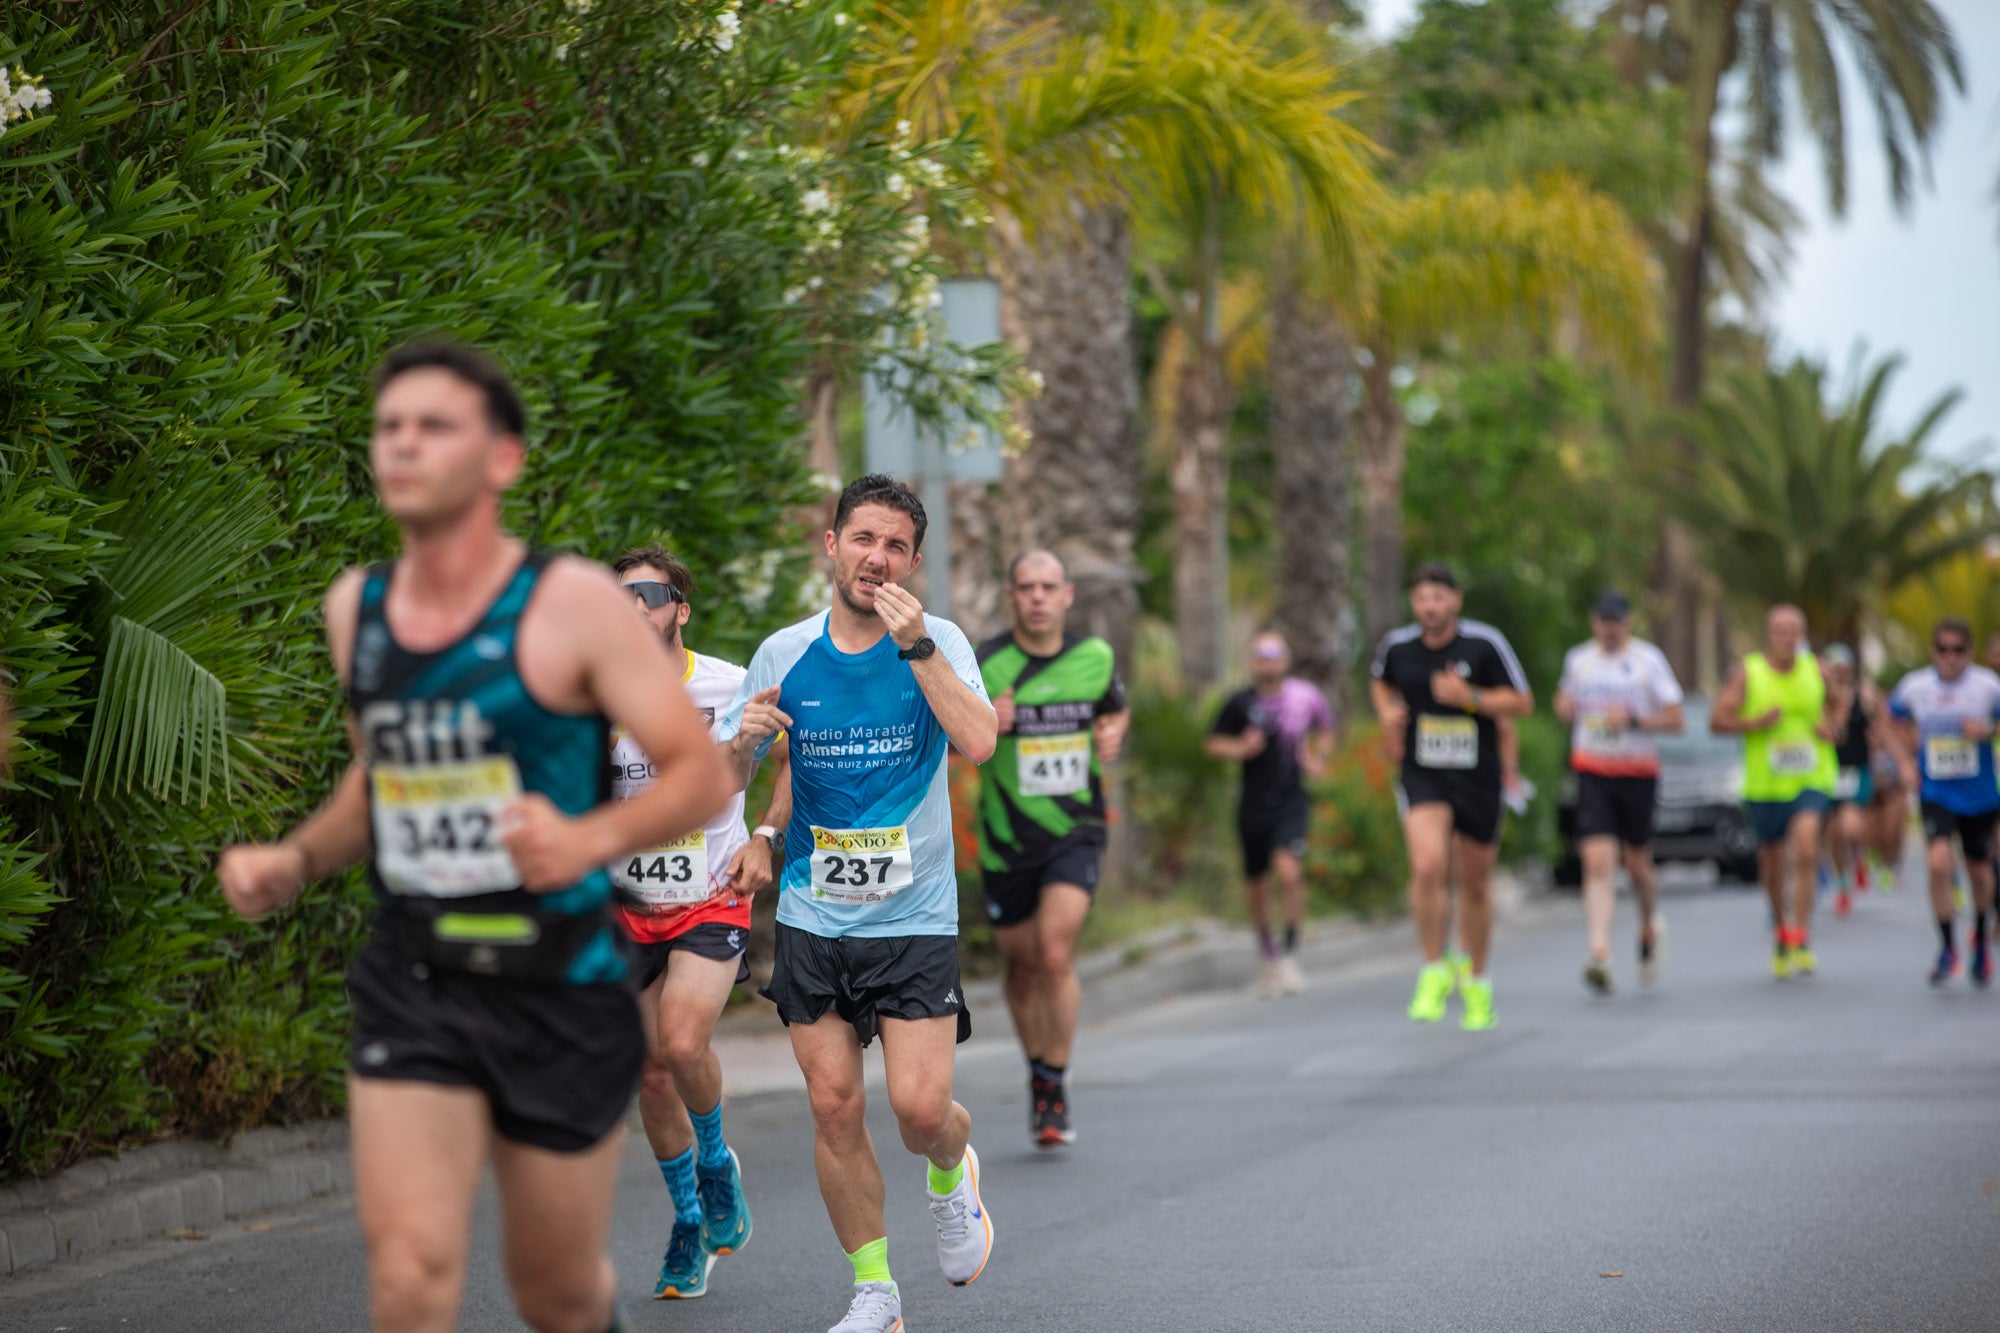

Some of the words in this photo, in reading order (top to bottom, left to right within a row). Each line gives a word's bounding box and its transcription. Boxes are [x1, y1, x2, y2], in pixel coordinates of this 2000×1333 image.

[799, 728, 843, 741] Medio
[849, 722, 915, 739] Maratón
[801, 740, 865, 757] Almería
[867, 735, 914, 755] 2025
[837, 760, 862, 769] RUIZ
[1033, 758, 1079, 779] 411
[399, 807, 495, 860] 342
[627, 855, 693, 883] 443
[824, 855, 893, 886] 237
